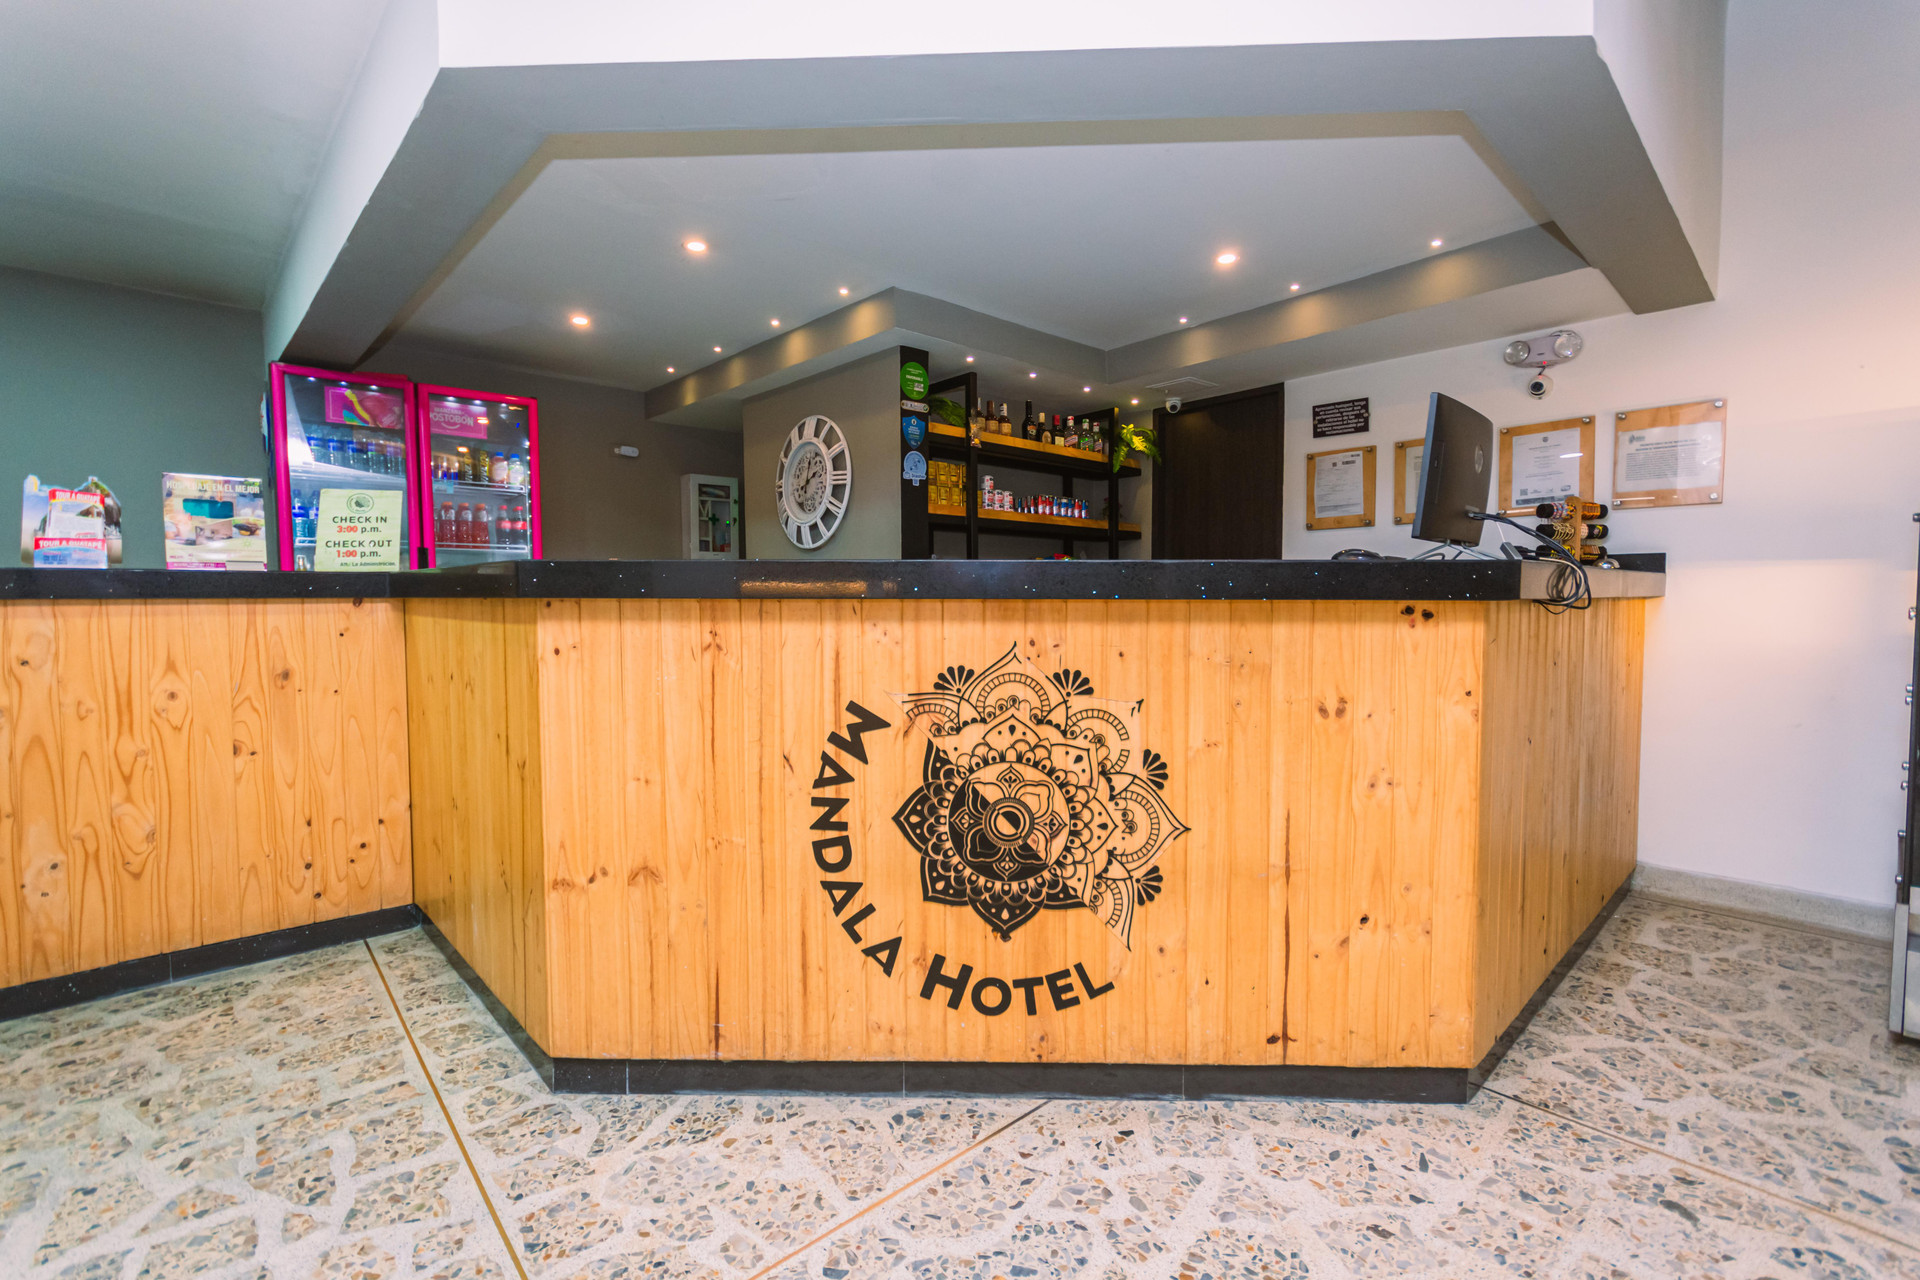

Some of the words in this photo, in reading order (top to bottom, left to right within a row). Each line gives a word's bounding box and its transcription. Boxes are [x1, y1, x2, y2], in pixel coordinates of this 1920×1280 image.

[235, 485, 259, 494] MEJOR
[55, 491, 70, 500] TOUR
[332, 516, 372, 524] CHECK
[39, 540, 59, 548] TOUR
[325, 540, 365, 548] CHECK
[810, 700, 902, 977] MANDALA
[920, 953, 1115, 1017] HOTEL
